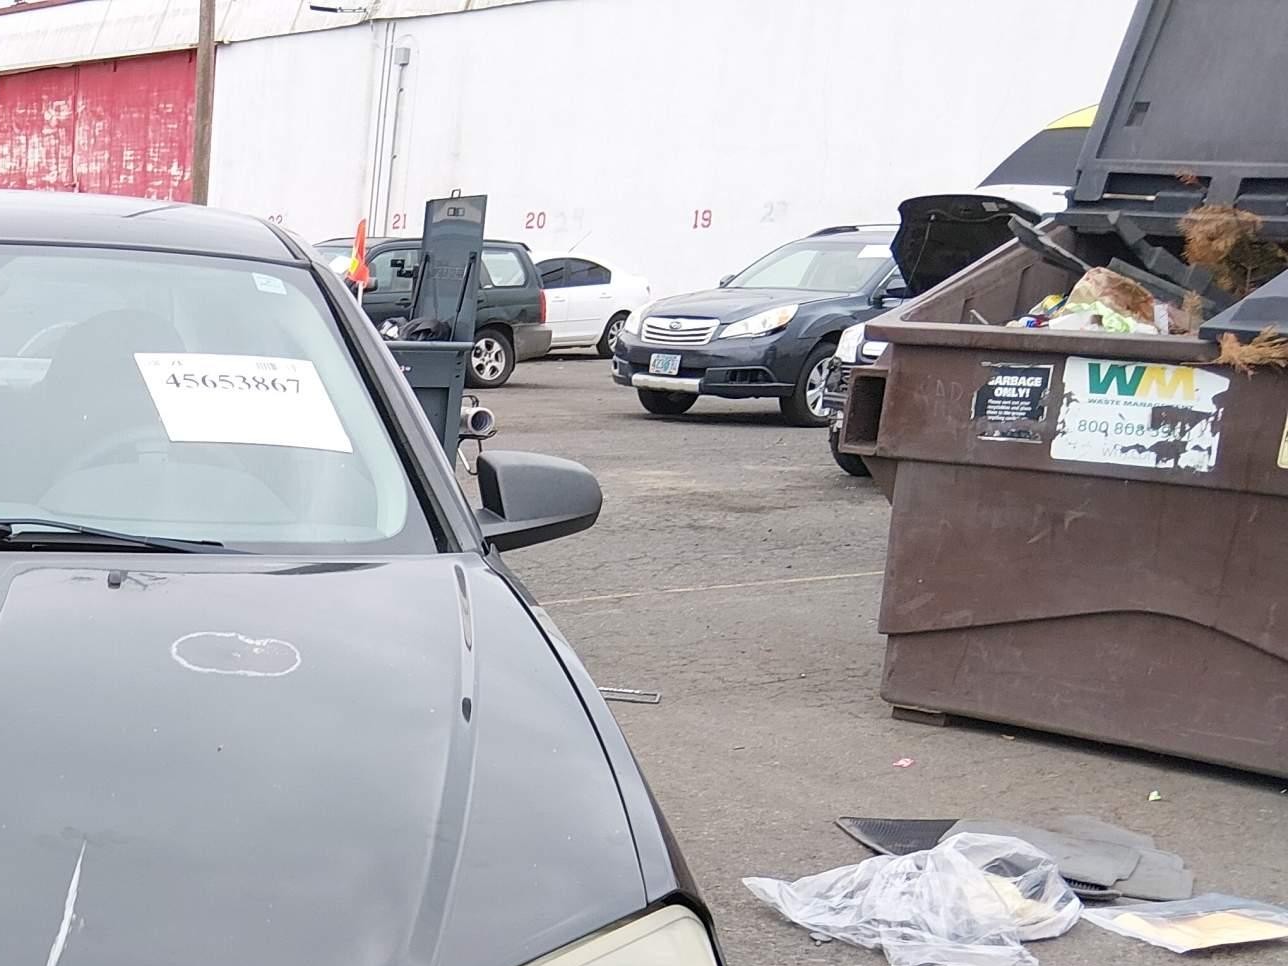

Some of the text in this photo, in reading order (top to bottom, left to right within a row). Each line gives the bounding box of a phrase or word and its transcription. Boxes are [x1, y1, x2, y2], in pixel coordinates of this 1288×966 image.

[392, 213, 407, 230] 21
[525, 212, 546, 229] 20
[692, 209, 712, 229] 19
[166, 373, 300, 394] 45653867
[1088, 362, 1196, 401] WM
[994, 386, 1030, 398] ONLY!
[1087, 398, 1121, 406] WASTE
[1077, 419, 1109, 434] 800
